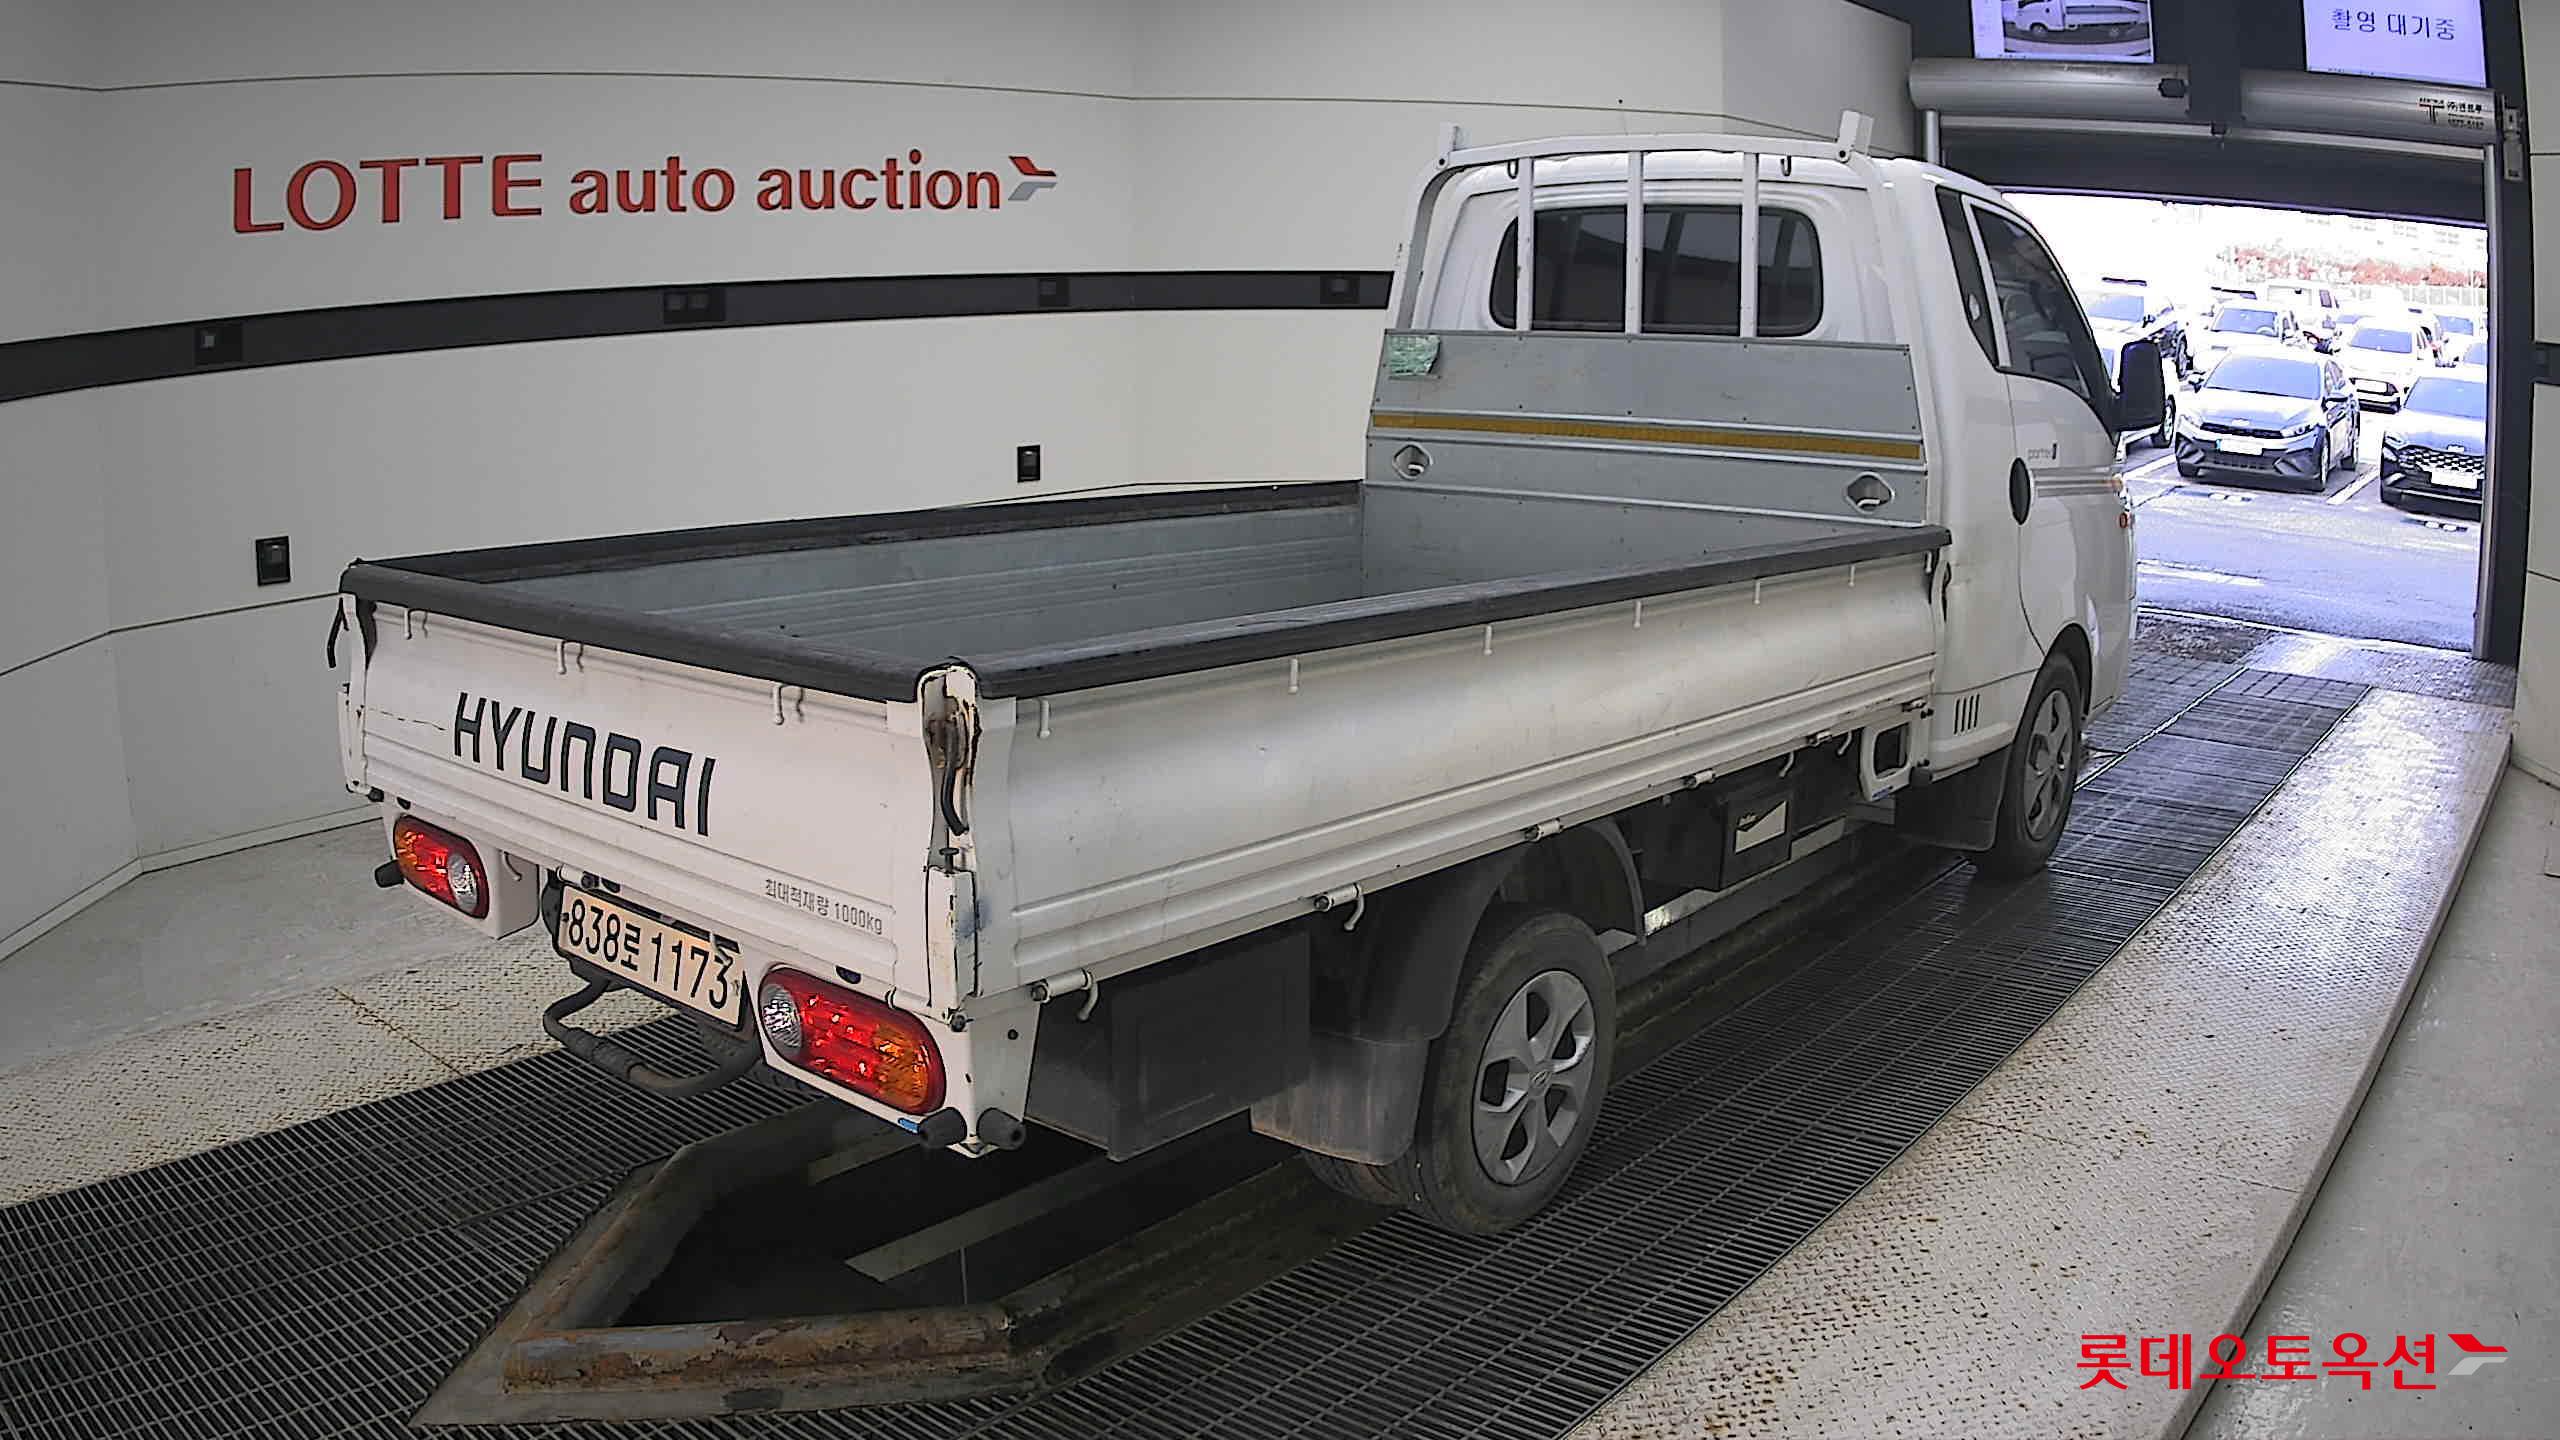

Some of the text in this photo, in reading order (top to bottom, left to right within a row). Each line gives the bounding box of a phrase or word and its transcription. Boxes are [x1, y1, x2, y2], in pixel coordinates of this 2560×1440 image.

[2332, 9, 2456, 41] 촬영 대기중
[233, 149, 1001, 234] LOTTE auto auction
[454, 692, 716, 836] HYUNDAI
[765, 879, 882, 935] 최대적재량 1000kg
